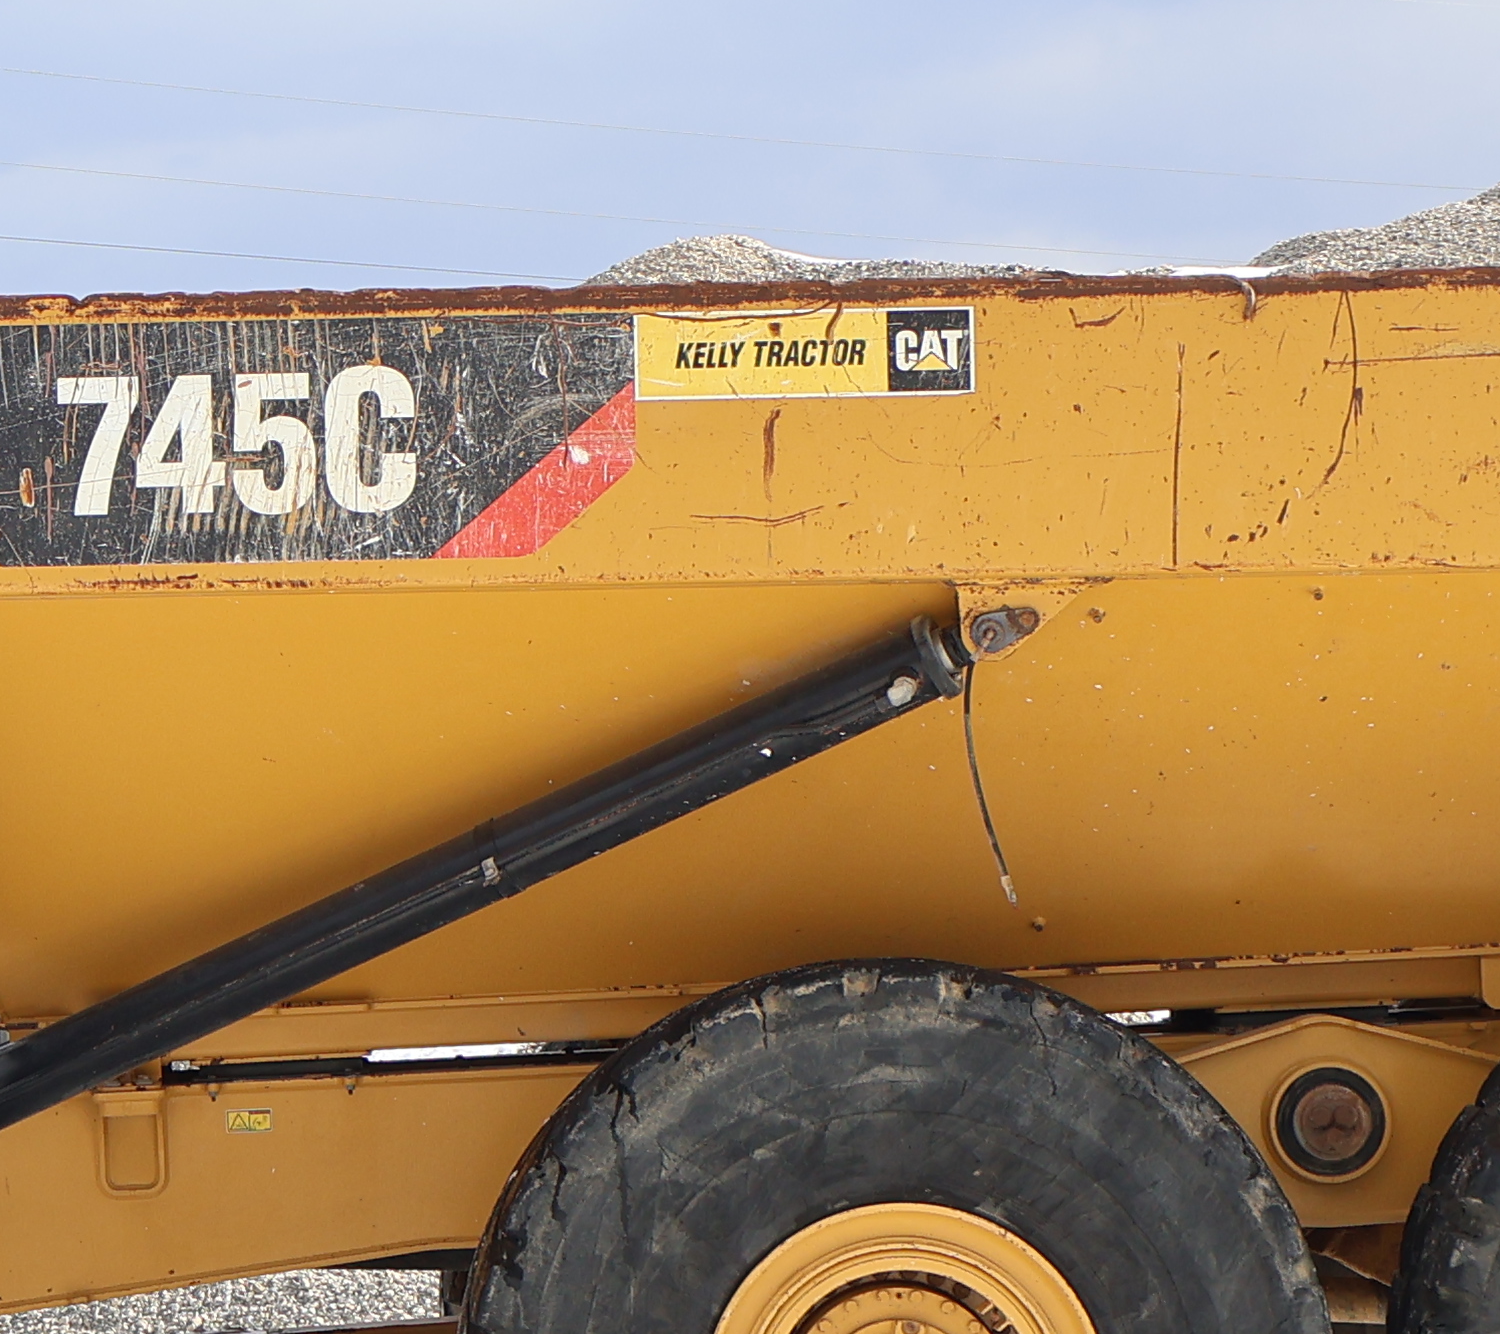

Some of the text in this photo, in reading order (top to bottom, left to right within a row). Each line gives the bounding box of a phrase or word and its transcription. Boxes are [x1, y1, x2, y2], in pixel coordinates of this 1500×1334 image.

[675, 337, 867, 369] KELLY TRACTOR
[894, 329, 964, 371] CAT
[55, 364, 418, 517] 745C
